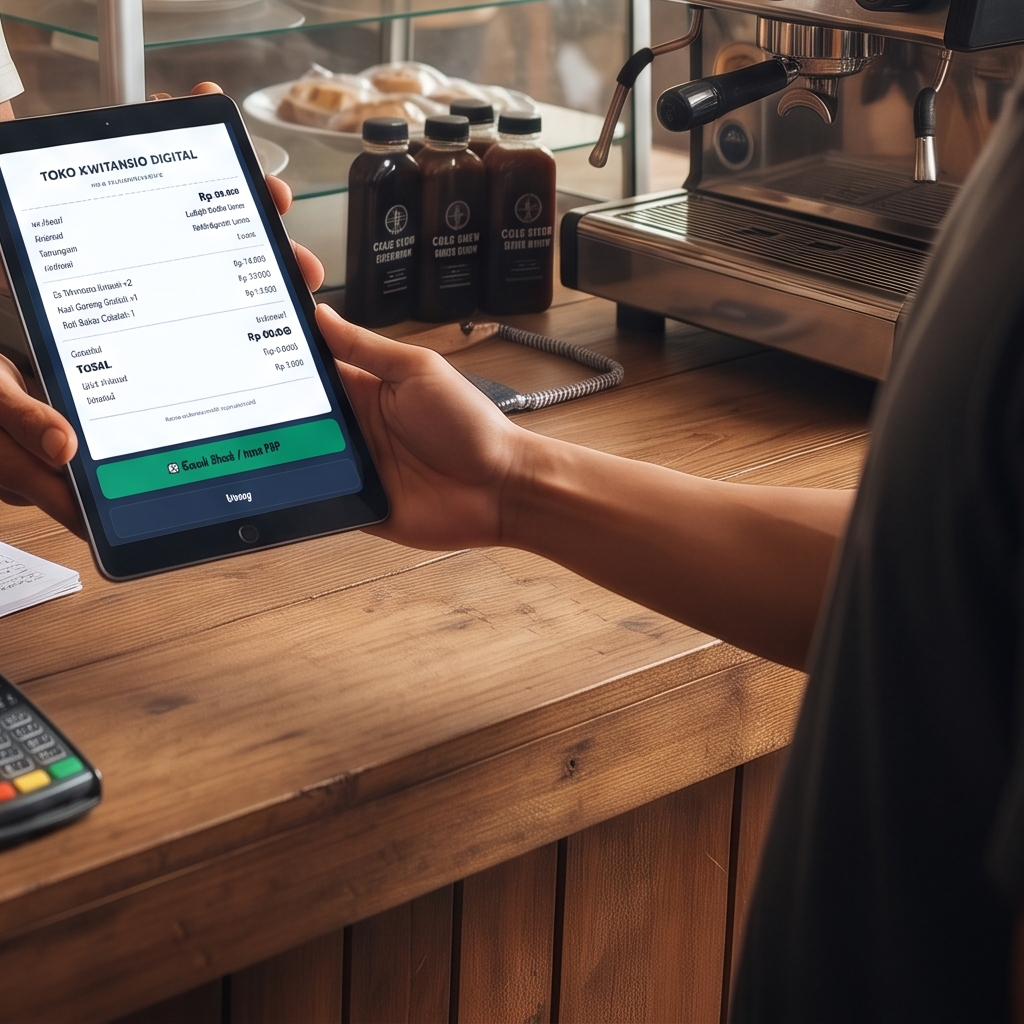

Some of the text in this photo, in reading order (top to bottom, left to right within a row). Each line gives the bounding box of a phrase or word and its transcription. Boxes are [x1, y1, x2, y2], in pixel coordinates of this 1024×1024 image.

[40, 167, 76, 182] TOKO
[79, 156, 148, 176] KWITANSIO
[150, 150, 198, 165] DIGITAL
[247, 332, 261, 342] Rp
